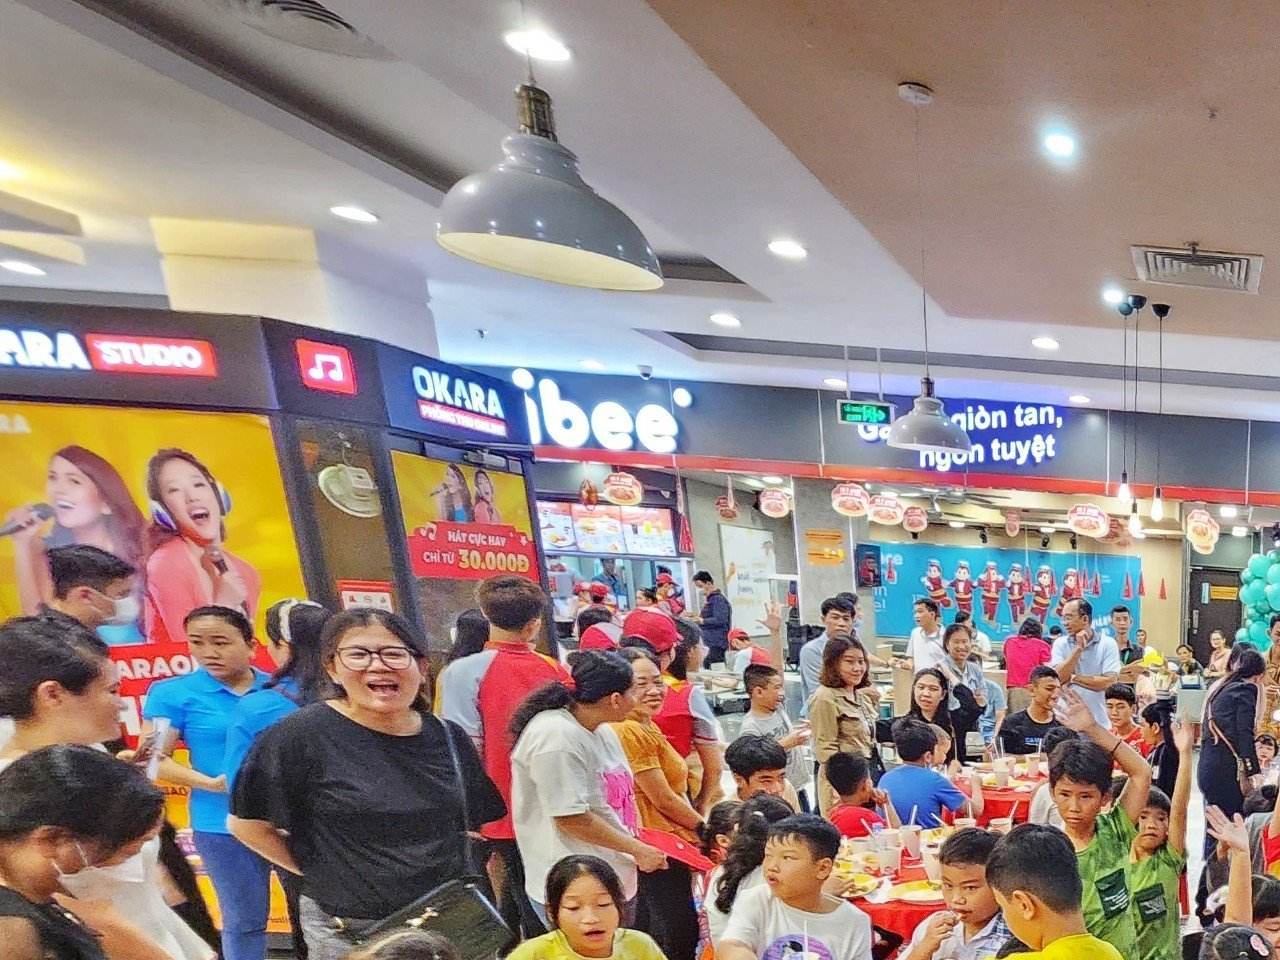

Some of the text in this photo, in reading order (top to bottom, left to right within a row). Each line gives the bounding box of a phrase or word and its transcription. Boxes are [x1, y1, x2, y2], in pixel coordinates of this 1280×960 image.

[97, 340, 203, 368] STUDIO
[412, 366, 505, 419] OKARA
[1014, 403, 1063, 428] tan,
[991, 434, 1056, 465] tuyệt
[448, 529, 506, 547] HÁT CỰC HAY
[423, 549, 441, 563] CHỈ
[458, 548, 530, 572] 30.000Đ
